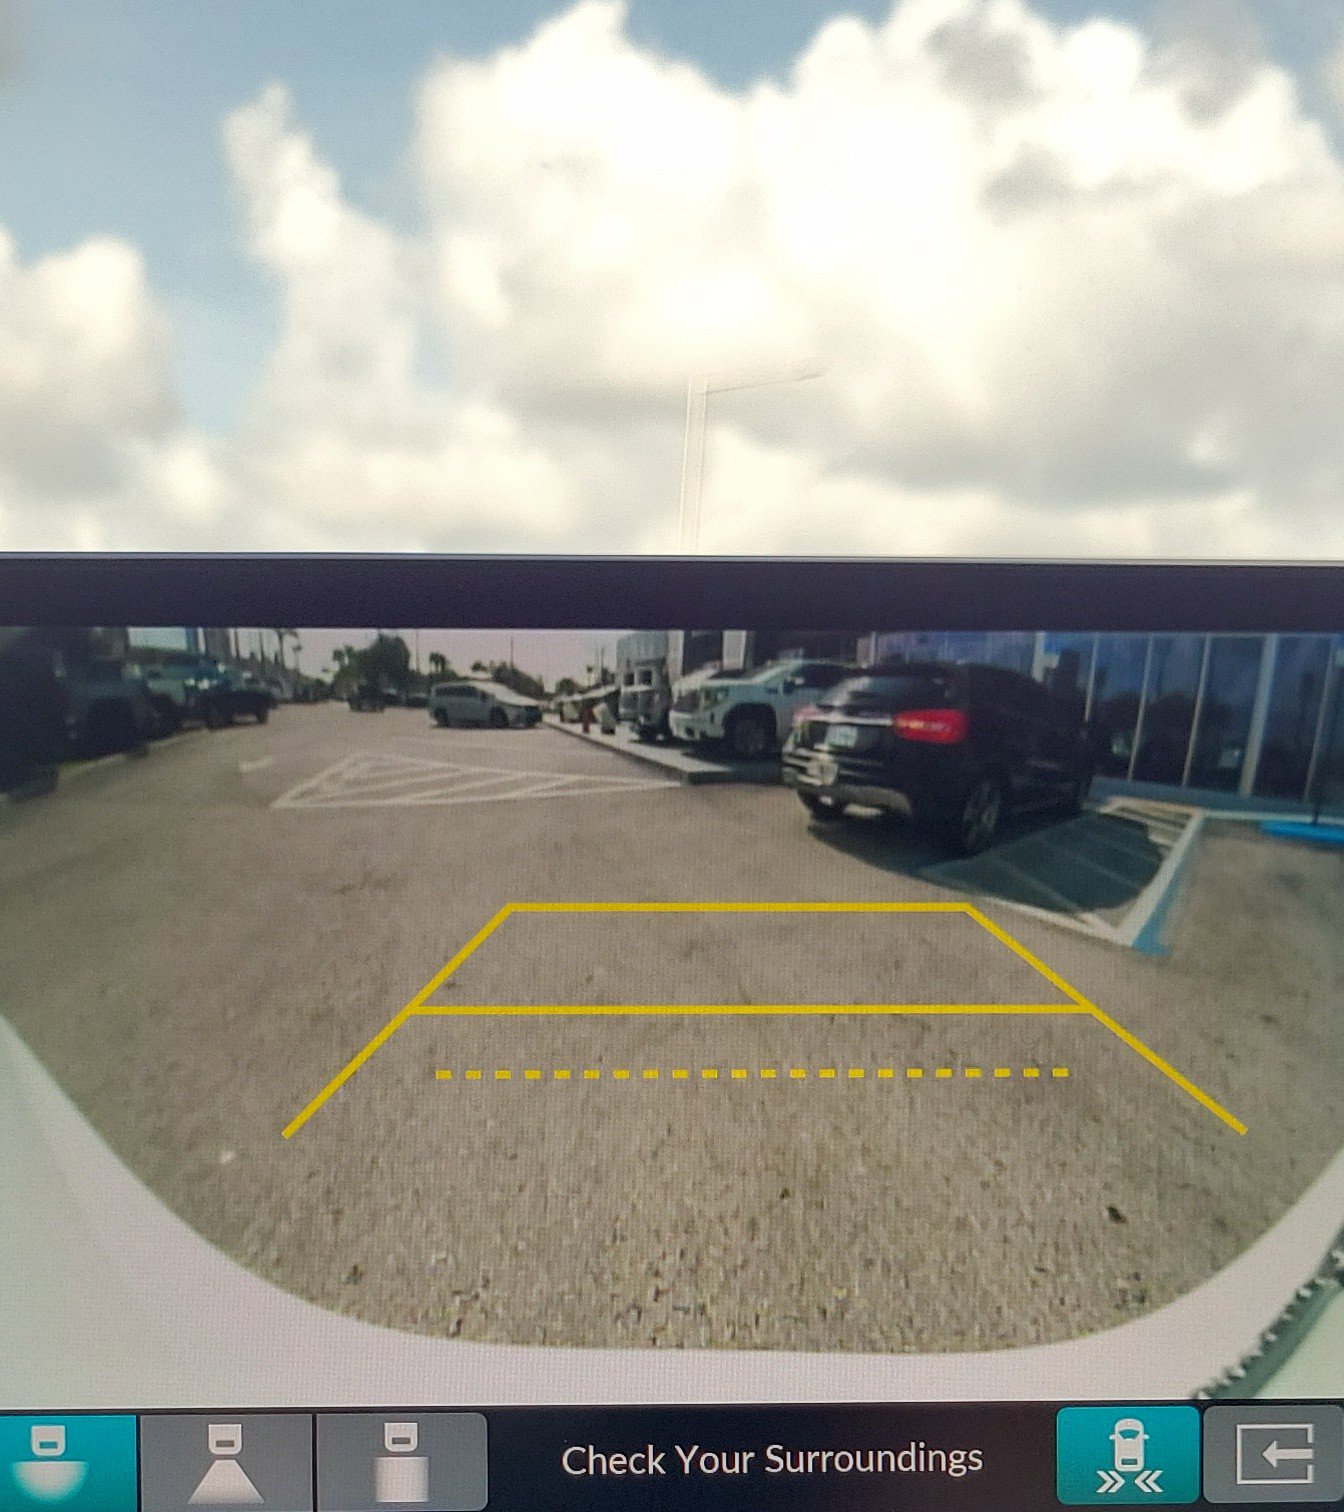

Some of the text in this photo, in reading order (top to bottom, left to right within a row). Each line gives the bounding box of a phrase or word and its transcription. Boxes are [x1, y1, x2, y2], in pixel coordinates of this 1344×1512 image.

[561, 1442, 984, 1477] Check Your Surroundings
